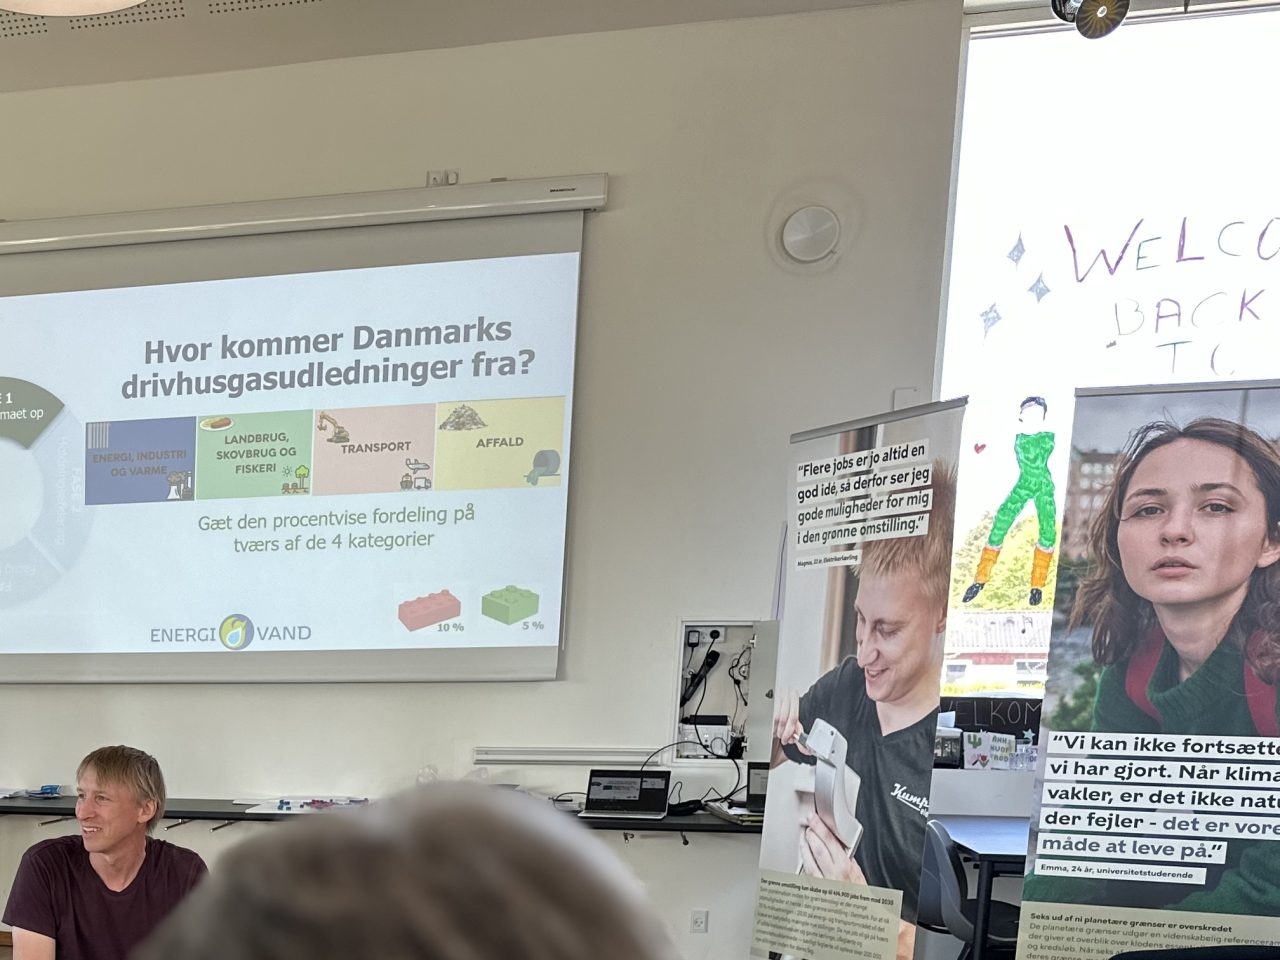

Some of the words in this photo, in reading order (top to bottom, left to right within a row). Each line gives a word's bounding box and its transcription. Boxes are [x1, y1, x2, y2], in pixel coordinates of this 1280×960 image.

[1114, 288, 1265, 335] BACK
[144, 339, 212, 365] Hvor
[220, 329, 343, 360] kommer
[353, 316, 512, 350] Danmarks
[121, 355, 462, 399] drivhusgasudledninger
[472, 349, 535, 377] fra?
[5, 392, 13, 404] 1
[30, 408, 44, 421] op
[224, 432, 289, 445] LANDBRUG,
[476, 437, 524, 449] AFFALD
[136, 450, 187, 461] INDUSTRI
[216, 448, 276, 461] SKOVBRUG
[279, 447, 297, 458] OG
[341, 441, 412, 455] TRANSPORT
[832, 456, 854, 476] jobs
[856, 454, 869, 467] er
[869, 451, 880, 468] jo
[882, 444, 909, 463] altid
[911, 444, 926, 457] en
[128, 465, 168, 476] VARME
[235, 463, 277, 475] FISKERI
[798, 484, 819, 504] god
[821, 480, 839, 497] idé,
[840, 478, 851, 493] så
[853, 473, 889, 491] derfor
[890, 471, 910, 485] ser
[911, 467, 930, 486] jeg
[798, 506, 824, 526] gode
[825, 498, 884, 518] muligheder
[886, 495, 904, 509] for
[906, 490, 930, 508] mig
[198, 515, 232, 531] Gæt
[237, 513, 267, 529] den
[273, 510, 367, 531] procentvise
[372, 506, 447, 526] fordeling
[454, 503, 475, 524] på
[234, 538, 280, 553] tværs
[284, 535, 301, 551] af
[306, 534, 327, 550] de
[331, 534, 342, 549] 4
[348, 531, 435, 551] kategorier
[802, 530, 820, 544] den
[822, 527, 858, 545] grønne
[150, 628, 216, 643] ENERGI
[256, 626, 312, 641] VAND
[437, 623, 450, 632] 10
[452, 623, 465, 632] %
[522, 622, 529, 631] 5
[532, 621, 545, 631] %
[1090, 736, 1128, 751] kan
[1133, 737, 1176, 753] ikke
[1050, 760, 1068, 775] vi
[1073, 761, 1109, 776] har
[1113, 763, 1172, 781] gjort.
[1179, 764, 1220, 780] Når
[1047, 786, 1114, 804] vakler,
[1119, 791, 1144, 804] er
[1148, 789, 1186, 805] det
[1191, 791, 1235, 807] ikke
[1240, 795, 1280, 809] nat
[1044, 811, 1082, 826] der
[1086, 812, 1144, 832] fejler
[1163, 816, 1200, 832] det
[1205, 821, 1230, 833] er
[1042, 836, 1101, 853] måde
[1105, 839, 1127, 854] at
[1132, 840, 1175, 856] leve
[1040, 863, 1070, 874] Emma,
[1071, 865, 1083, 873] 24
[1096, 867, 1194, 879] universitetstuderende
[1030, 913, 1050, 921] Seks
[1064, 914, 1073, 922] af
[1075, 915, 1083, 923] ni
[1084, 916, 1128, 926] planetære
[1130, 919, 1167, 929] grænser
[1179, 924, 1233, 933] overskredet
[1028, 932, 1042, 940] der
[1043, 935, 1065, 943] giver
[1076, 936, 1109, 945] overblik
[1130, 940, 1163, 949] klodens
[1042, 923, 1084, 933] planetære
[1085, 925, 1121, 936] grænser
[1162, 932, 1222, 944] videnskabelig
[1026, 952, 1049, 960] deres
